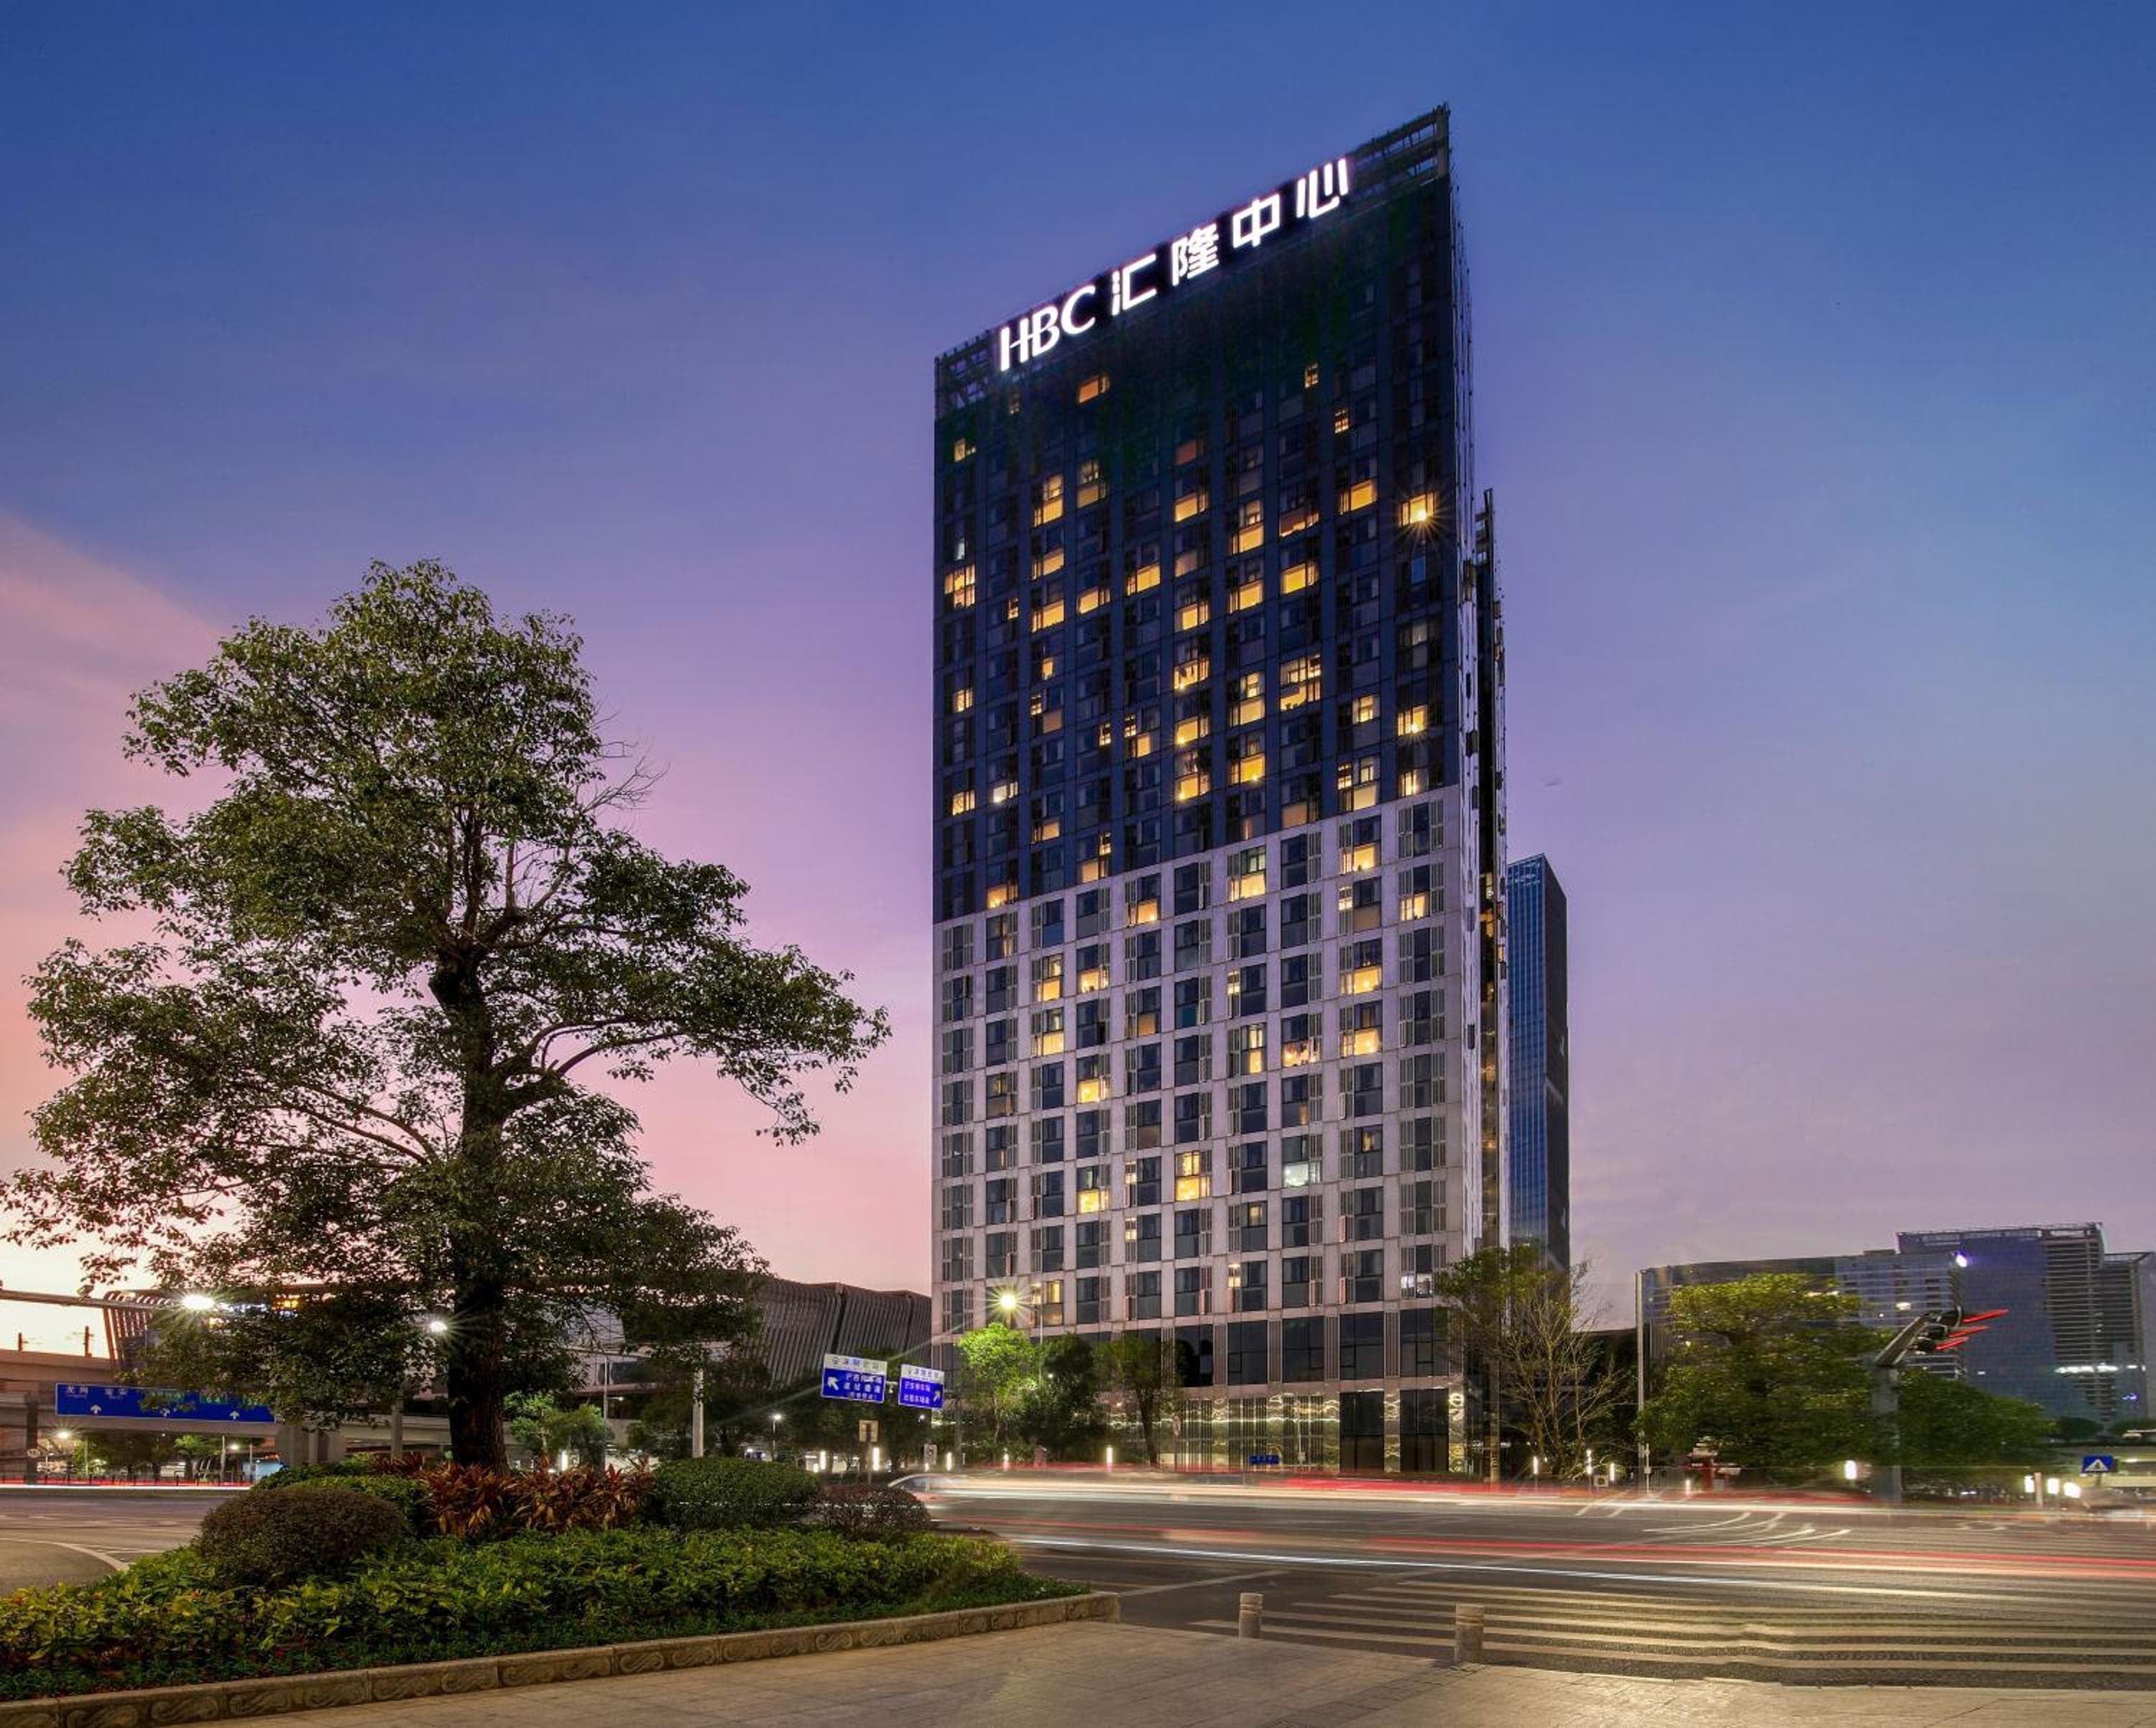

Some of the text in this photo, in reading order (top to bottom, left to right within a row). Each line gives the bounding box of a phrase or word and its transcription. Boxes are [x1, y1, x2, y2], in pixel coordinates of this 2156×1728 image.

[1000, 158, 1348, 371] HBC 汇隆中心
